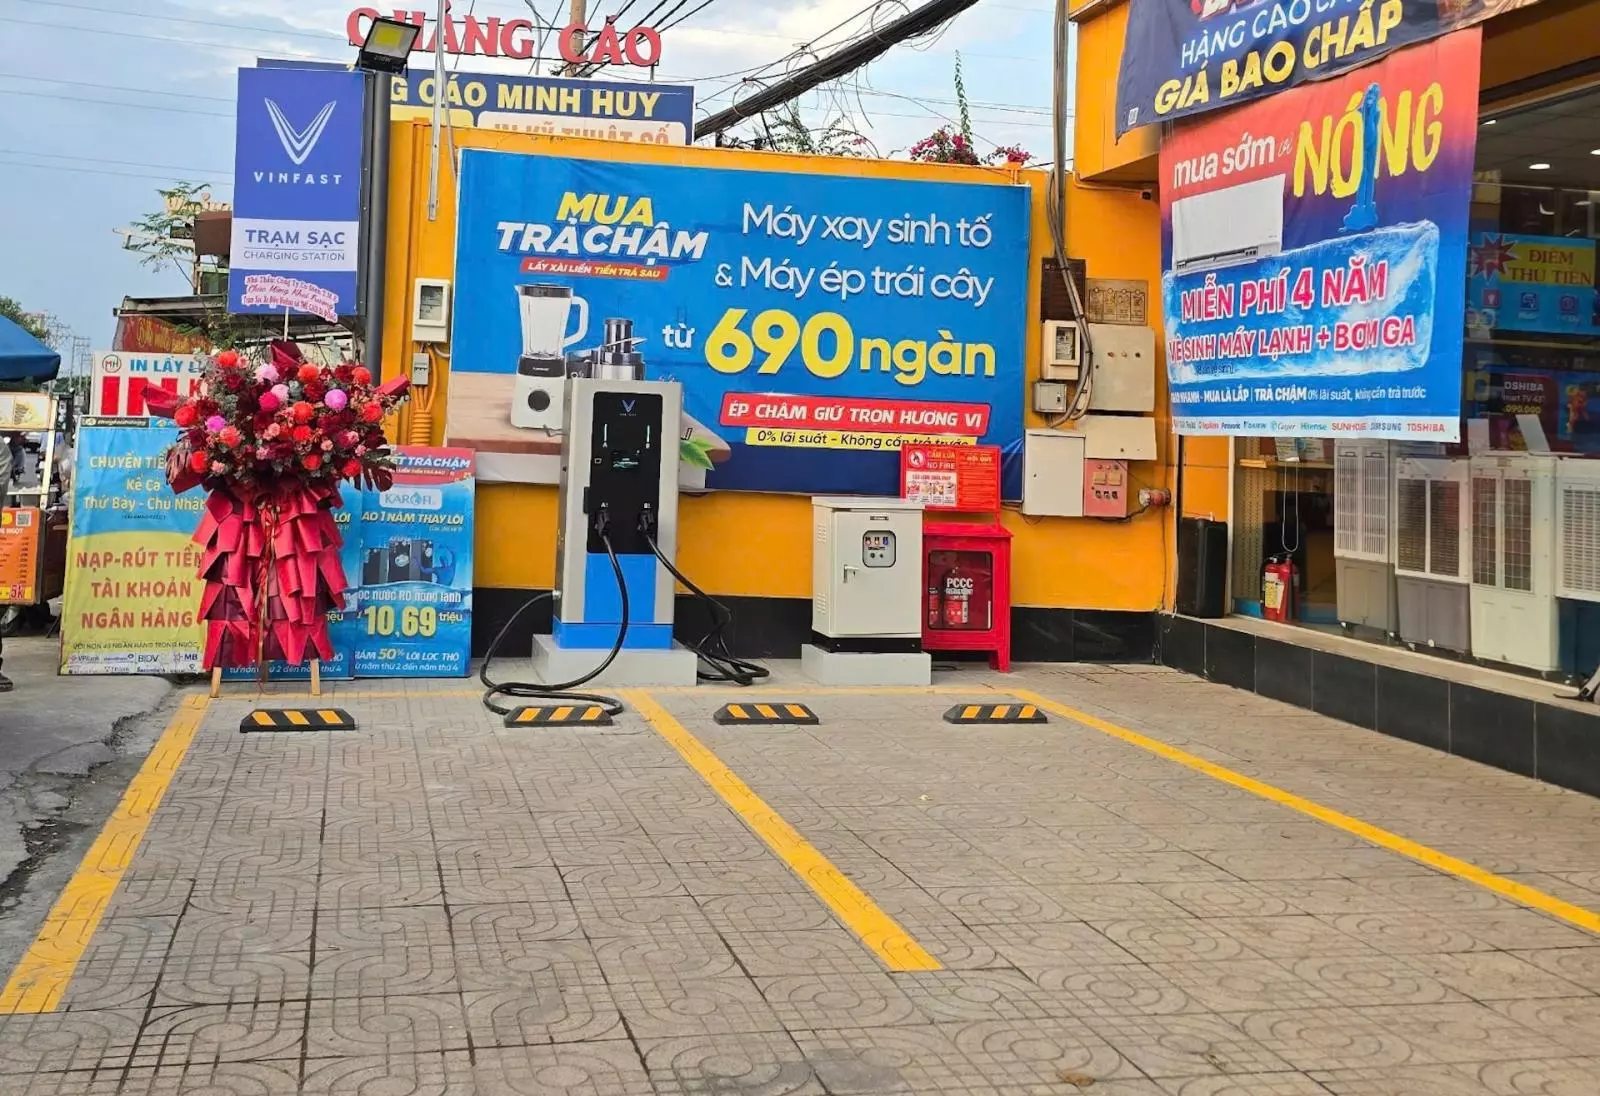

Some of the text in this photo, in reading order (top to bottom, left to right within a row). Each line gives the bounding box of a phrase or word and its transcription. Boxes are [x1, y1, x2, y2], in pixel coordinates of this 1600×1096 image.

[558, 15, 661, 67] CÁO
[1181, 20, 1246, 68] HÀNG
[1252, 0, 1310, 39] CAO
[1154, 0, 1403, 115] GIÁ BAO CHẤP
[497, 83, 581, 114] MINH
[592, 89, 661, 117] HUY
[1173, 153, 1218, 189] mua
[1222, 132, 1275, 174] sớm
[254, 172, 342, 185] VINFAST
[556, 192, 654, 227] MUA
[742, 202, 993, 248] Máy xay sinh tố
[245, 229, 345, 248] TRẠM SẠC
[243, 250, 345, 261] CHARGING STATION
[639, 269, 660, 277] SAU
[715, 255, 994, 307] & Máy ép trái cây
[1182, 255, 1388, 323] MIỄN PHÍ 4 NĂM
[662, 308, 996, 385] từ 690 ngàn
[1183, 334, 1216, 362] SINH
[1218, 325, 1256, 359] MÁY
[1258, 325, 1312, 361] LẠNH
[1334, 319, 1379, 351] BƠM
[1382, 315, 1415, 347] GA
[130, 359, 147, 371] IN
[154, 356, 184, 372] LẤY
[1254, 384, 1274, 401] TRẢ
[1275, 384, 1307, 404] CHẬM
[1504, 381, 1544, 391] OSHIBA
[728, 400, 749, 417] ÉP
[900, 410, 958, 426] HƯƠNG
[1407, 423, 1445, 432] TOSHIBA
[757, 430, 776, 442] 0%
[780, 431, 795, 443] lãi
[799, 432, 827, 444] suất
[841, 434, 882, 449] Không
[90, 450, 166, 469] CHUYỂN TIỀ
[127, 473, 142, 490] Kể
[84, 495, 204, 513] Thứ Bảy Chủ Nhật
[361, 512, 378, 521] AO
[418, 514, 446, 524] THAY
[76, 547, 158, 572] NẠP-RÚT
[91, 576, 191, 598] TÀI KHOẢN
[947, 578, 973, 588] PCCC
[82, 607, 192, 629] NGÂN HÀNG
[439, 611, 463, 624] triệu
